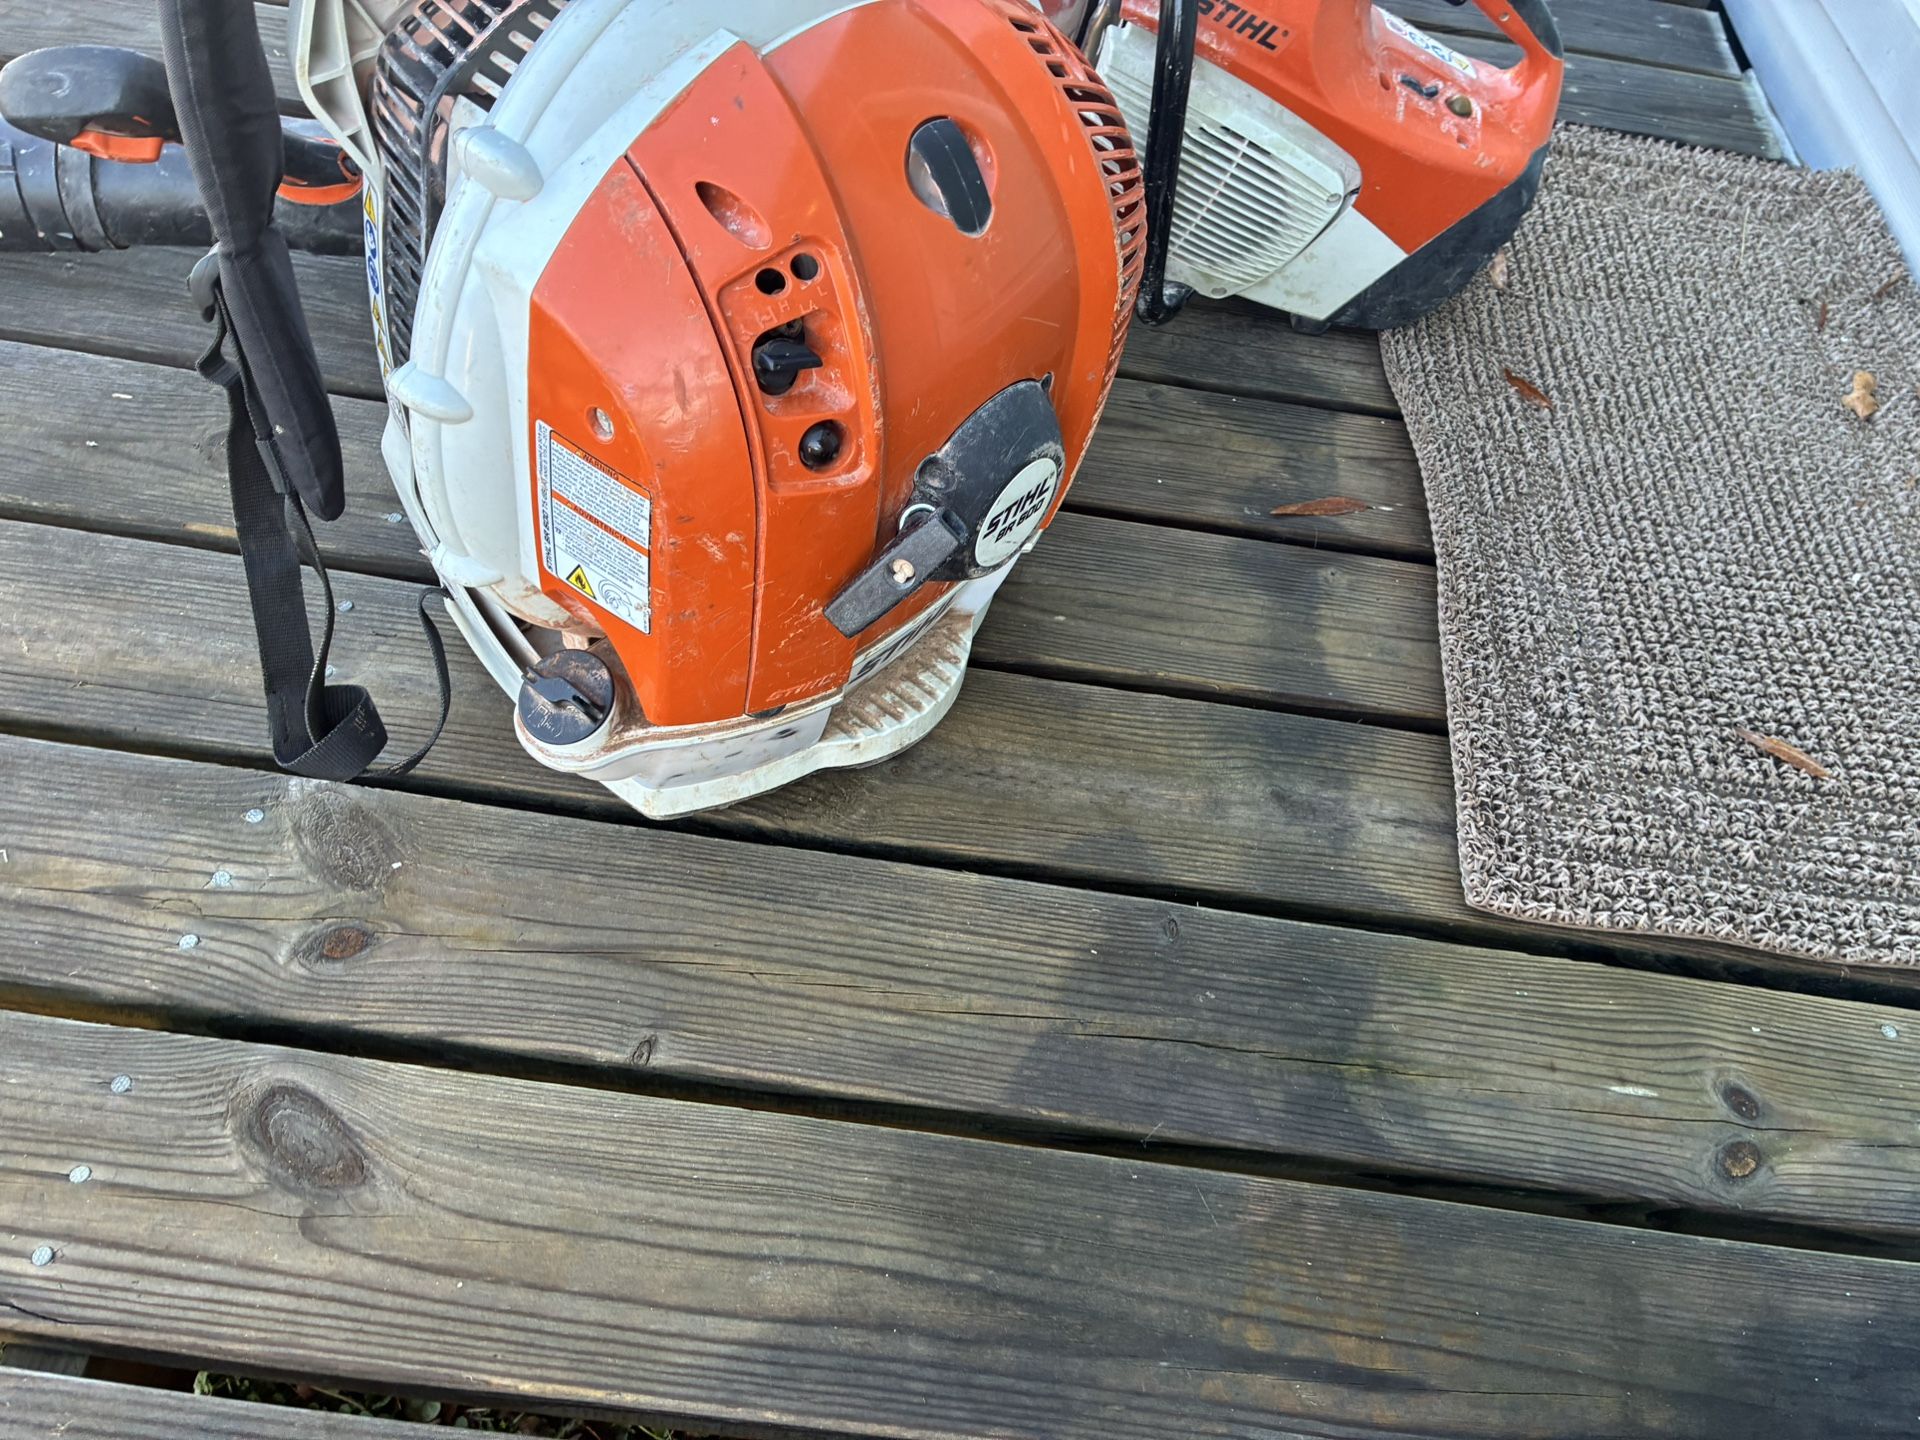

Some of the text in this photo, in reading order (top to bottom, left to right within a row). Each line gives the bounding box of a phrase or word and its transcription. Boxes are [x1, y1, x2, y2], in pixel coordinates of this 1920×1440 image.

[582, 453, 620, 481] WARNING
[573, 505, 628, 544] ADVERTENCIA
[982, 476, 1051, 540] STIHL
[994, 497, 1045, 544] BR 600
